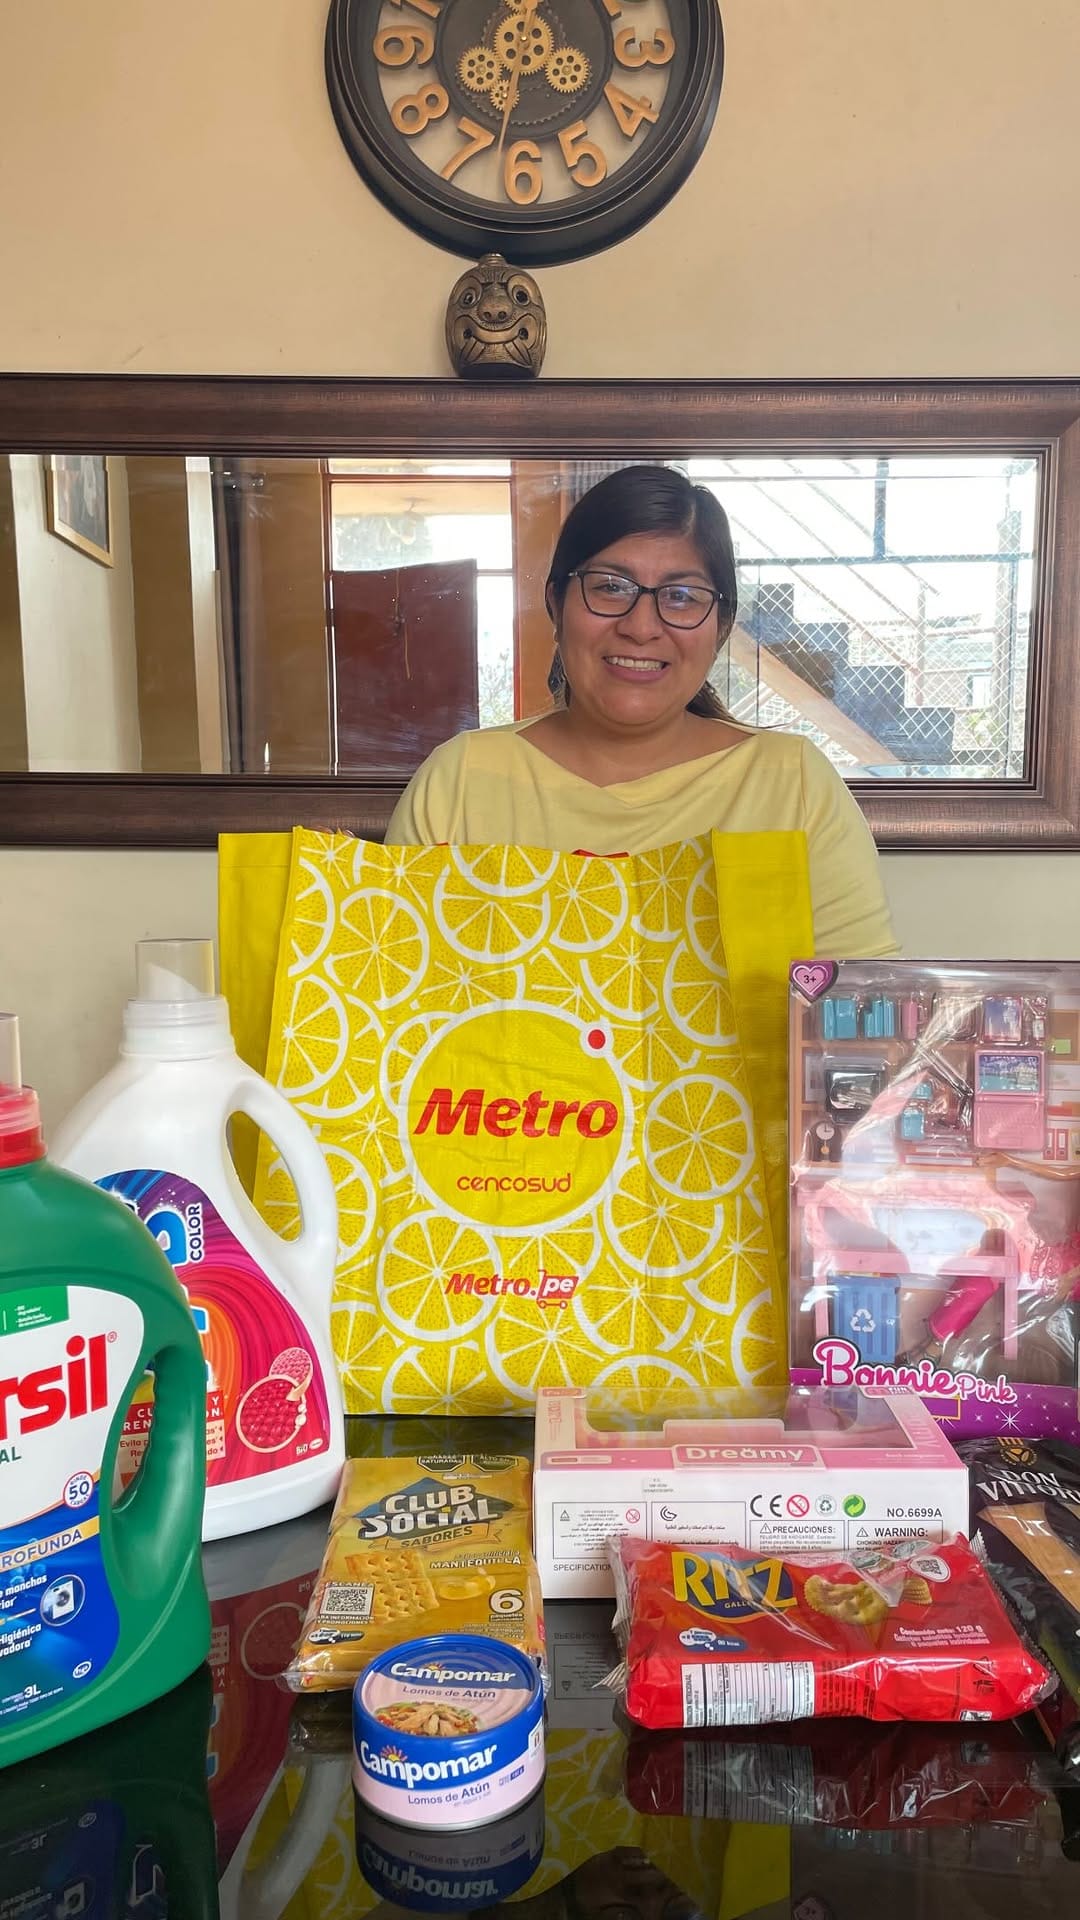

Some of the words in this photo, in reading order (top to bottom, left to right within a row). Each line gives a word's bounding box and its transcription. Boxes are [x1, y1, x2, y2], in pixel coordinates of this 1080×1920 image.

[373, 25, 435, 66] 9
[614, 27, 675, 67] 3
[391, 84, 449, 135] 8
[605, 82, 659, 137] 4
[440, 117, 496, 180] 7
[558, 120, 607, 187] 5
[504, 140, 543, 205] 6
[803, 975, 817, 984] 3+
[413, 1088, 618, 1138] Metro
[457, 1173, 571, 1193] cencosud
[188, 1205, 202, 1261] COLOR
[0, 1334, 108, 1441] rsil
[816, 1340, 958, 1394] Bonnie
[957, 1374, 1015, 1403] Pink
[0, 1446, 21, 1464] AL
[69, 1480, 90, 1500] 50
[385, 1485, 475, 1514] CLUB
[2, 1528, 82, 1568] ROFUNDA
[400, 1525, 474, 1548] SABORES
[875, 1527, 928, 1537] WARNING:
[6, 1575, 48, 1597] manchas
[671, 1552, 798, 1607] RITZ
[490, 1589, 523, 1613] 6
[24, 1684, 41, 1699] 3L
[391, 1662, 516, 1684] Campomar
[402, 1685, 442, 1697] Lomos
[444, 1688, 460, 1697] de
[462, 1689, 497, 1699] Atún
[360, 1740, 498, 1789] Campomar
[407, 1794, 443, 1805] Lomos
[445, 1791, 459, 1803] de
[461, 1780, 491, 1799] Atún
